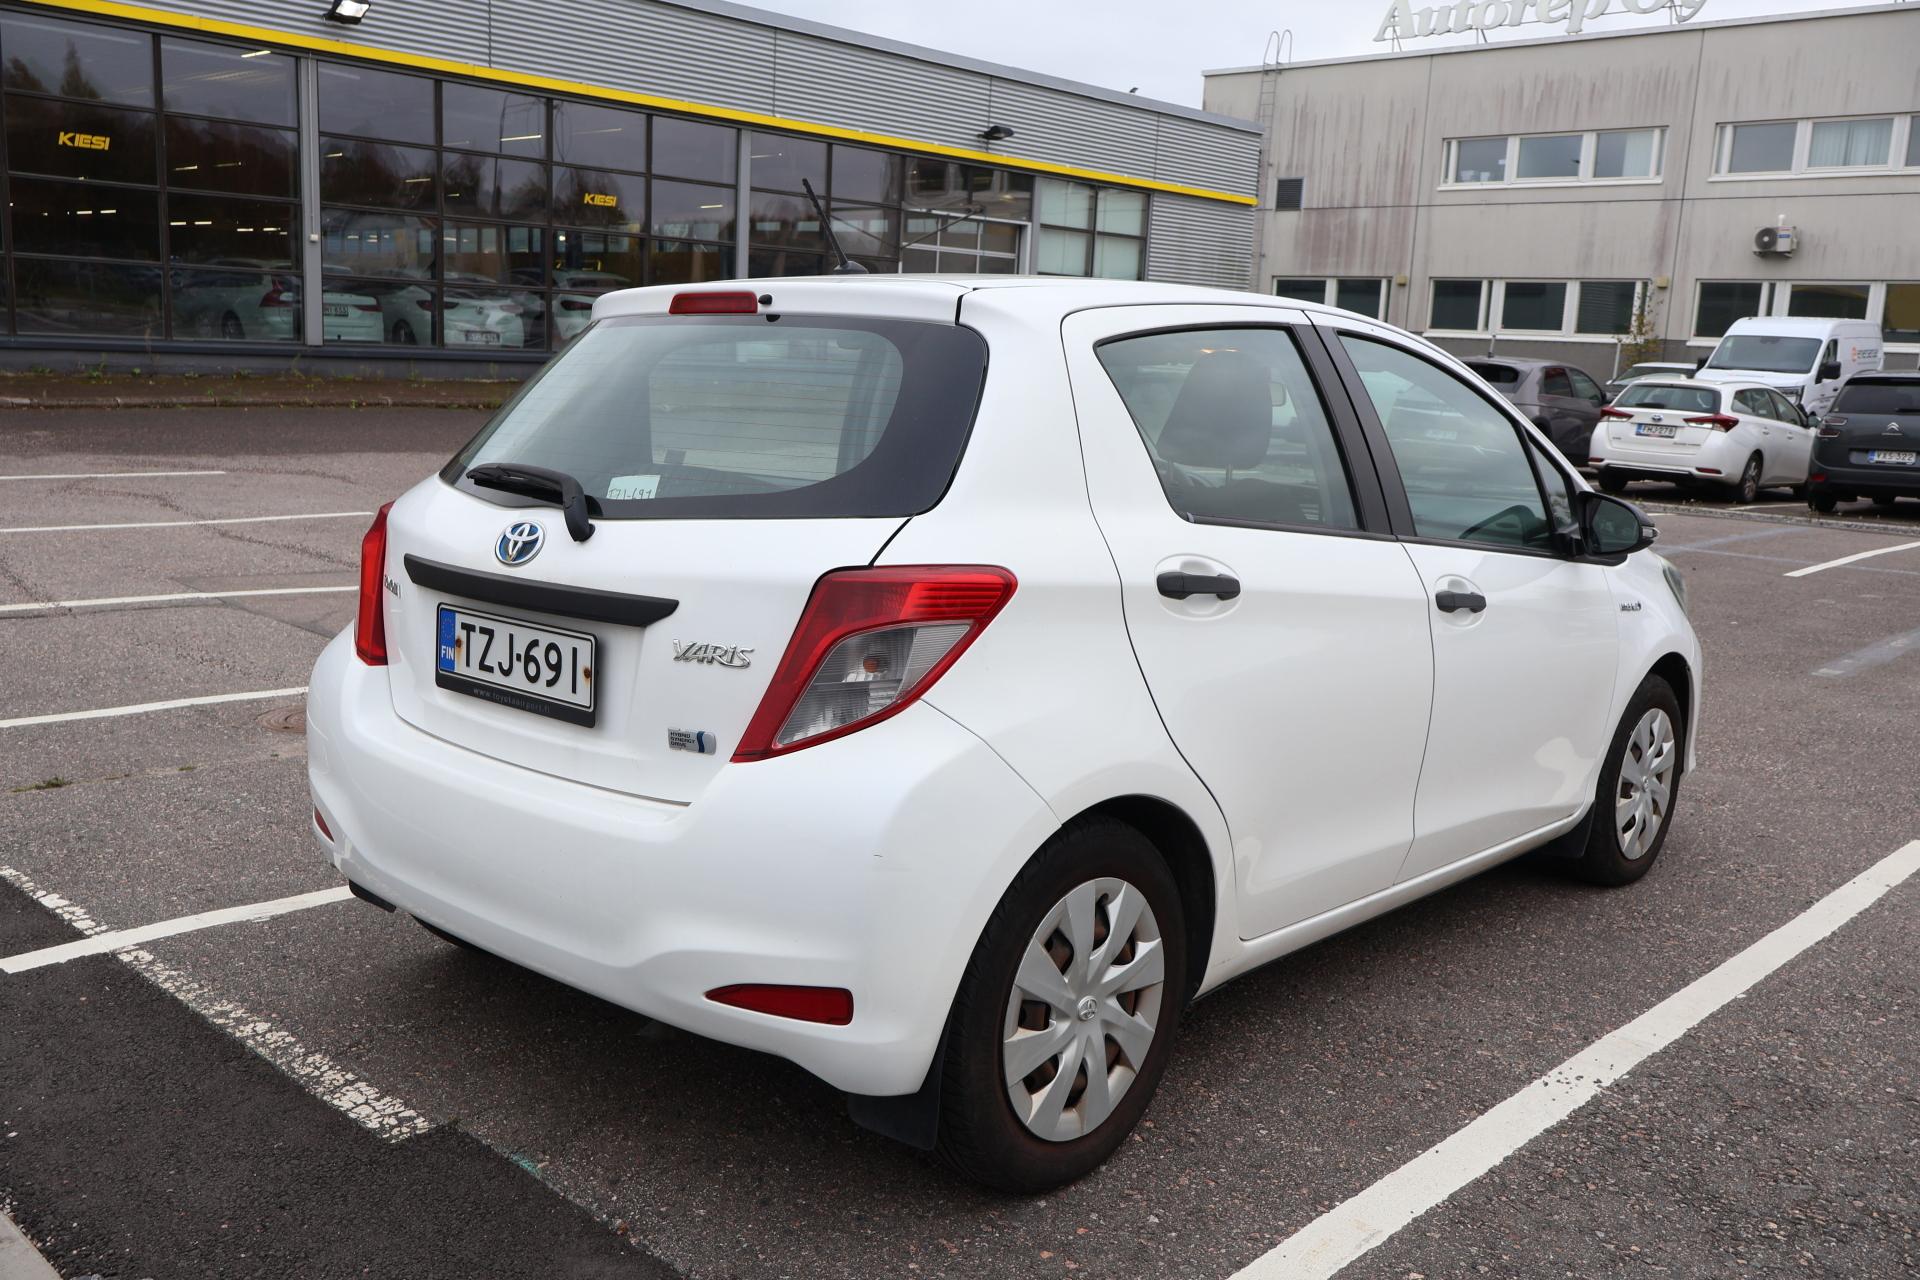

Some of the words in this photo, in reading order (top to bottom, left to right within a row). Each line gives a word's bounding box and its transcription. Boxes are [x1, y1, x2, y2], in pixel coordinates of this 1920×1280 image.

[1373, 0, 1610, 41] Autorep
[58, 131, 111, 151] KIESI
[584, 192, 617, 208] KIESI
[441, 645, 455, 660] FIN
[460, 621, 578, 695] TZJ-691
